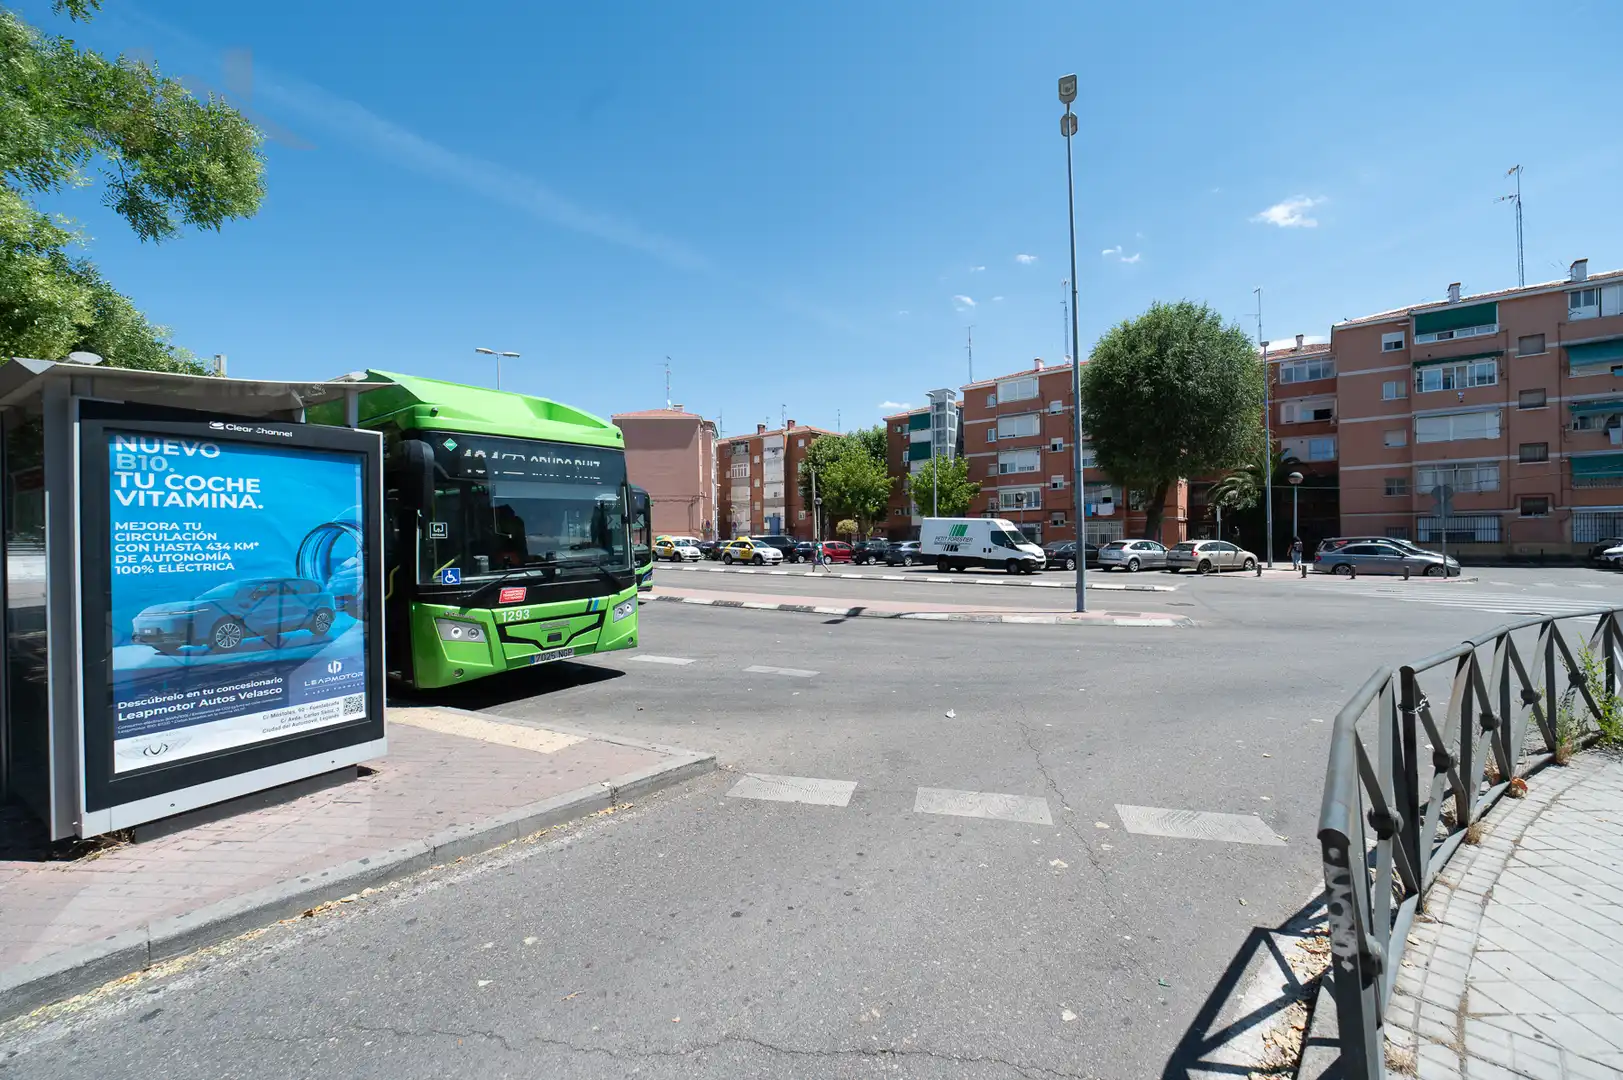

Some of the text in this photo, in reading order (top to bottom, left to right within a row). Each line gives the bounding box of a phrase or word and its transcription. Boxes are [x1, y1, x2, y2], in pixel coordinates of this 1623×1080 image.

[225, 423, 293, 438] Clear Channel
[116, 435, 220, 458] NUEVO
[116, 454, 175, 472] B10.
[114, 471, 261, 494] TU COCHE
[114, 490, 264, 509] VITAMINA.
[115, 521, 202, 531] MEJORA TU
[115, 530, 217, 542] CIRCULACIÓN
[115, 543, 150, 553] CON
[154, 543, 202, 552] HASTA
[206, 542, 231, 551] 434
[115, 551, 232, 564] DE AUTONOMÍA
[115, 561, 235, 575] 100% ELÉCTRICA
[502, 609, 531, 622] 1293
[535, 647, 574, 663] 7025 NGP
[304, 671, 364, 687] LEAPMOTOR
[117, 676, 283, 710] Descúbrelo en tu concesionario
[118, 701, 196, 722] Leapmotor
[199, 694, 236, 708] Autos
[238, 687, 283, 701] Velasco
